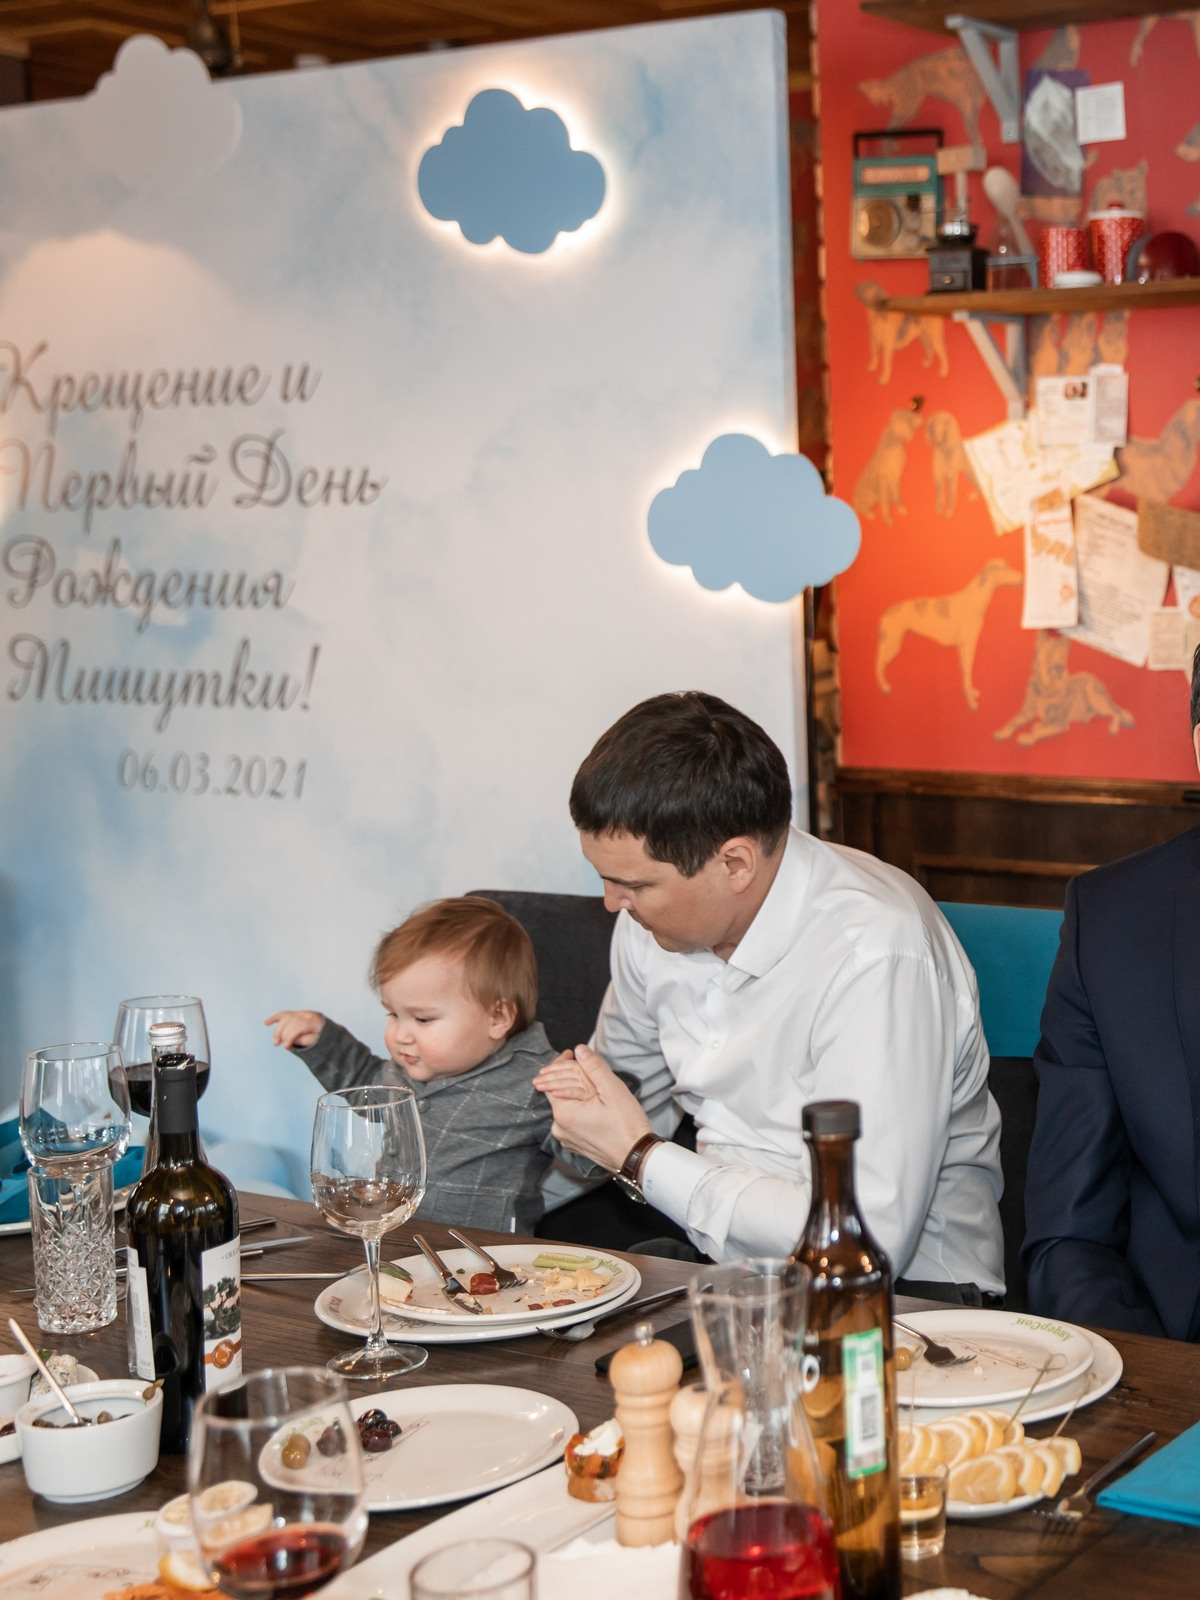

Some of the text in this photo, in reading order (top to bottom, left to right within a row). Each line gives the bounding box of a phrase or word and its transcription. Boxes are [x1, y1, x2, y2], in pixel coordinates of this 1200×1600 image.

[0, 340, 323, 438] Крещение и
[0, 428, 390, 535] Первый День
[3, 534, 296, 634] Рождения
[7, 633, 321, 733] Мишутки!
[116, 747, 309, 799] 06.03.2021
